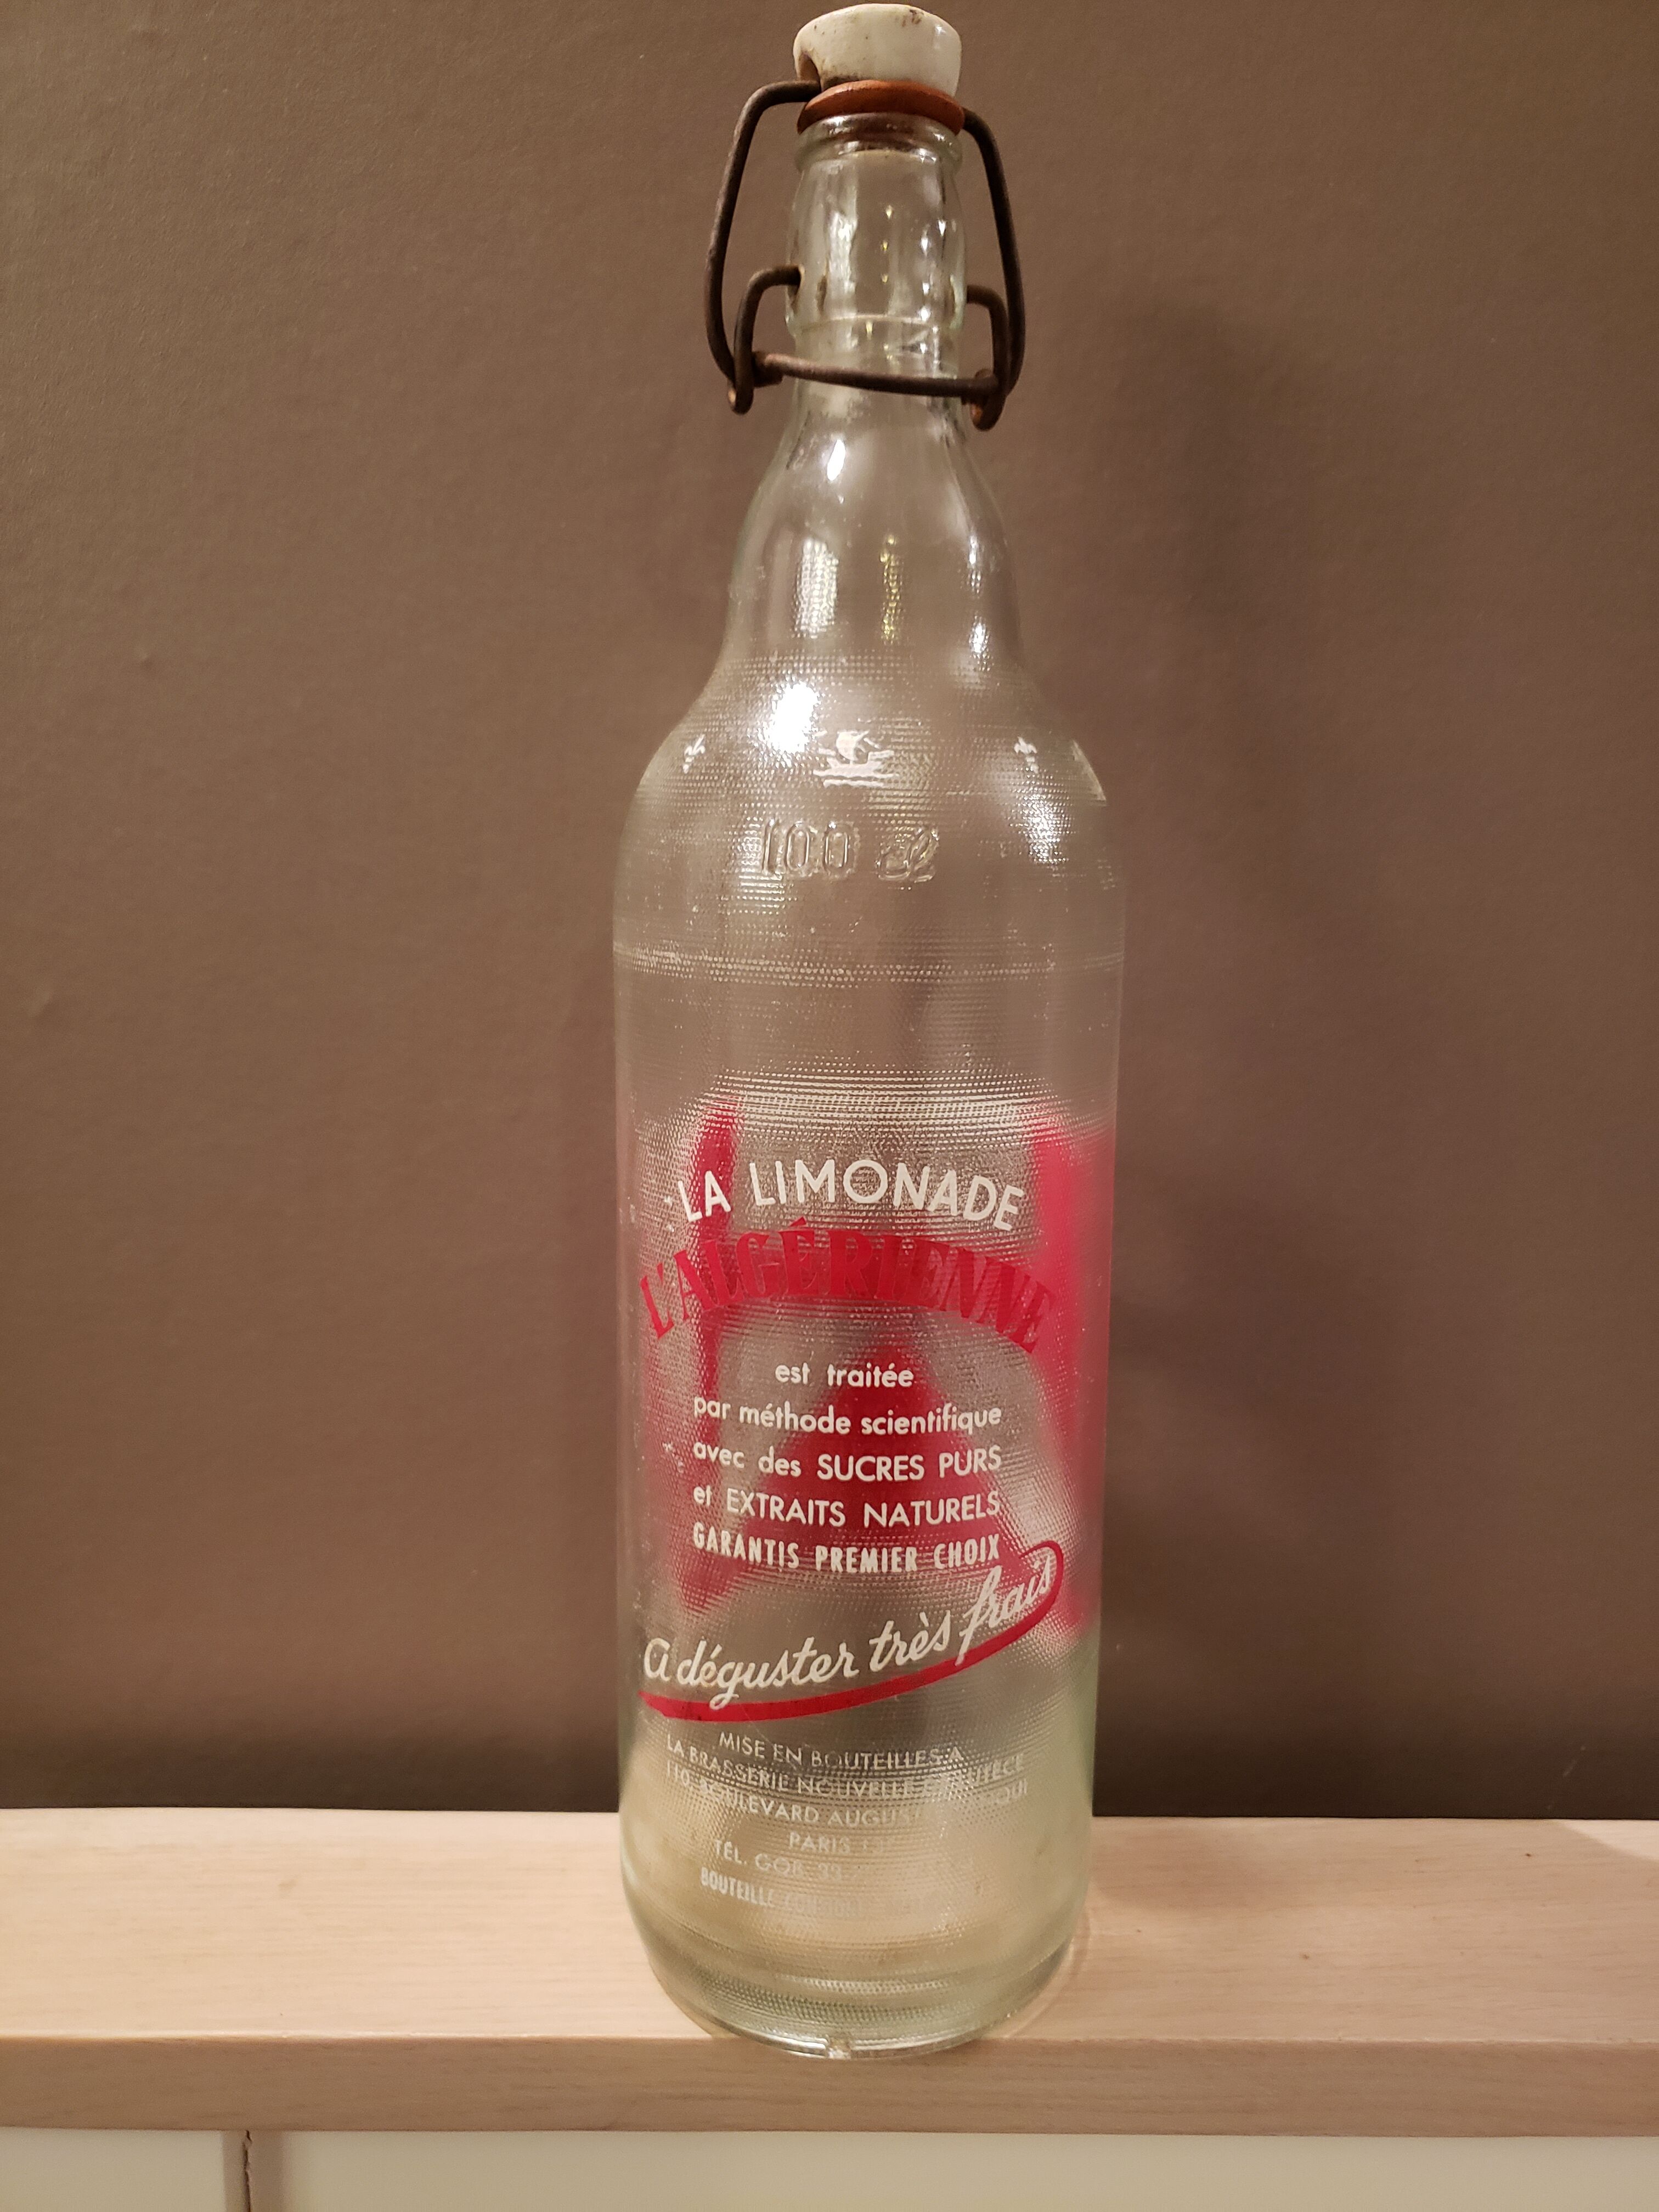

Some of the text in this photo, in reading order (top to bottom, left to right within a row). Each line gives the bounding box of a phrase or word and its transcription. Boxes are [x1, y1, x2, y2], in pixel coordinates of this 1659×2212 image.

[678, 1159, 1024, 1231] LA LIMONADE
[640, 1216, 1056, 1353] L'ALGÉRIENNE
[775, 1363, 915, 1387] est traitée
[693, 1396, 1002, 1436] par méthode scientifique
[693, 1441, 1002, 1481] avec des SUCRES PURS
[693, 1485, 1001, 1528] et EXTRAITS NATURELS
[693, 1522, 1000, 1573] GARANTIS PREMIER CHOIX
[677, 1635, 860, 1711] déguster
[869, 1610, 952, 1674] très
[955, 1556, 1054, 1666] frais
[667, 1733, 685, 1757] LA
[690, 1746, 788, 1792] BRASSERIE
[719, 1731, 765, 1759] MISE
[773, 1743, 803, 1765] EN
[789, 1831, 850, 1855] PARIS
[699, 1866, 776, 1908] BOUTEILLE
